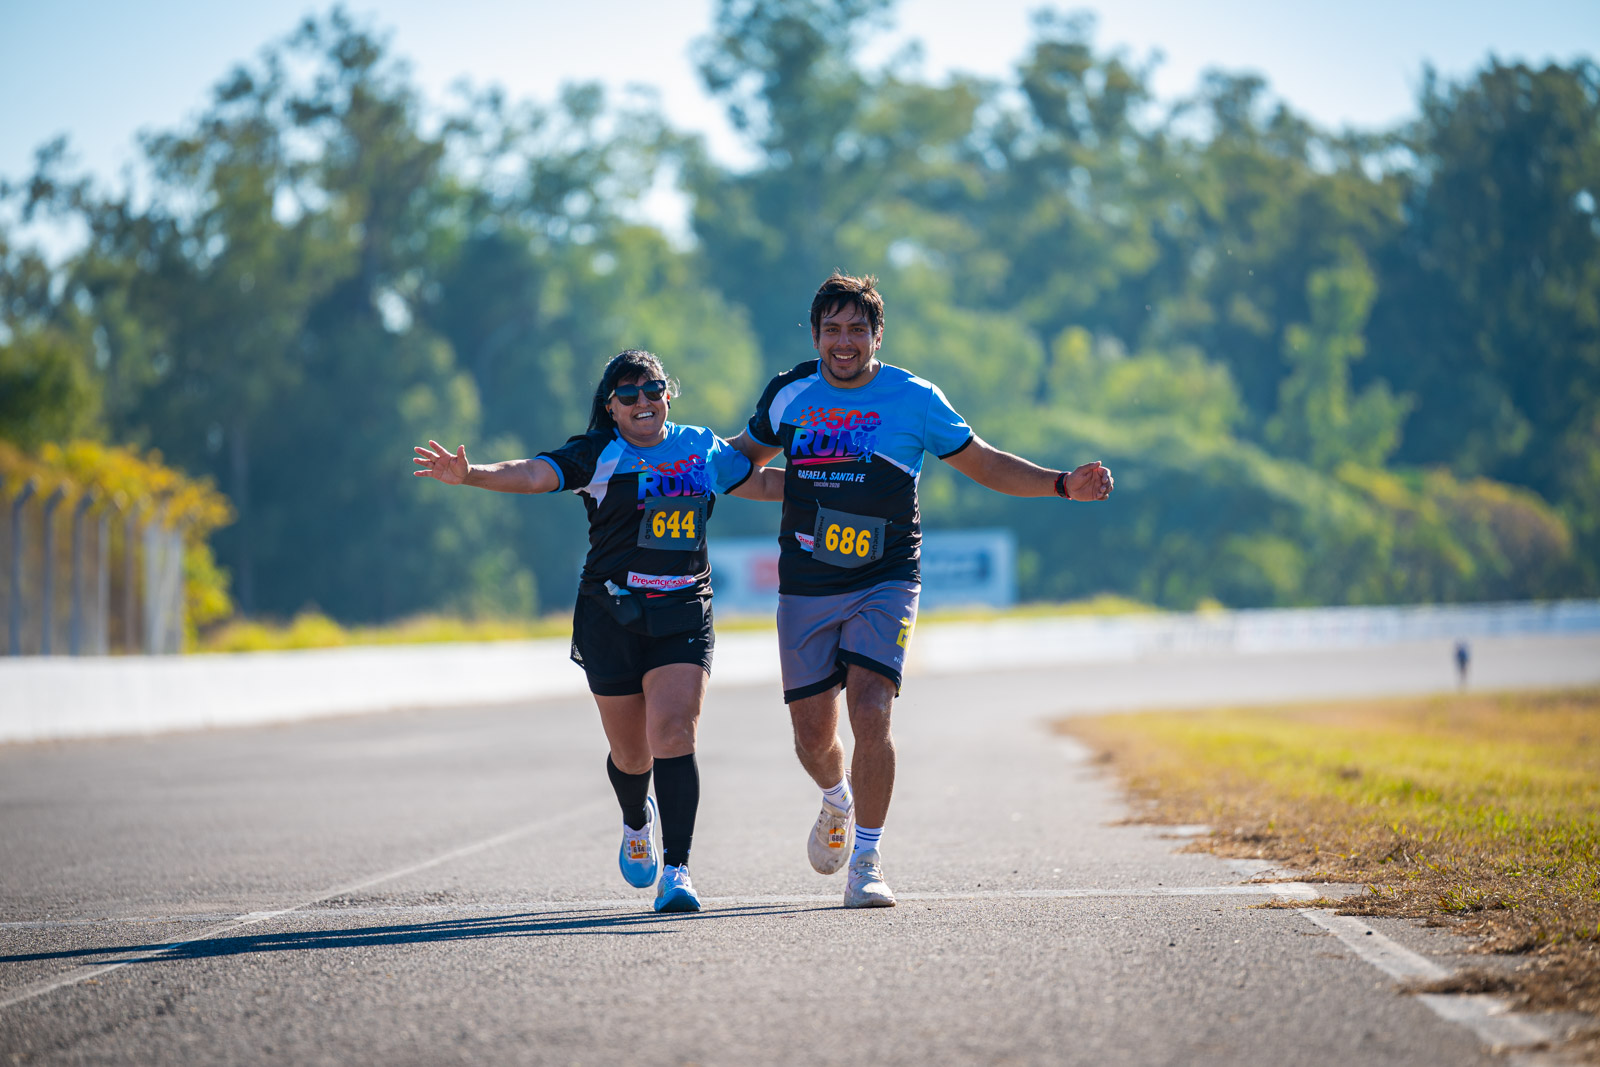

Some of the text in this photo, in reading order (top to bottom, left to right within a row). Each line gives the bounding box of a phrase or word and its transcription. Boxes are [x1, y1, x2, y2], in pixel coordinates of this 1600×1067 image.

[791, 427, 866, 457] RUN
[798, 469, 866, 483] RAFAELA, SANTA FE
[652, 510, 696, 538] 644
[825, 523, 872, 557] 686
